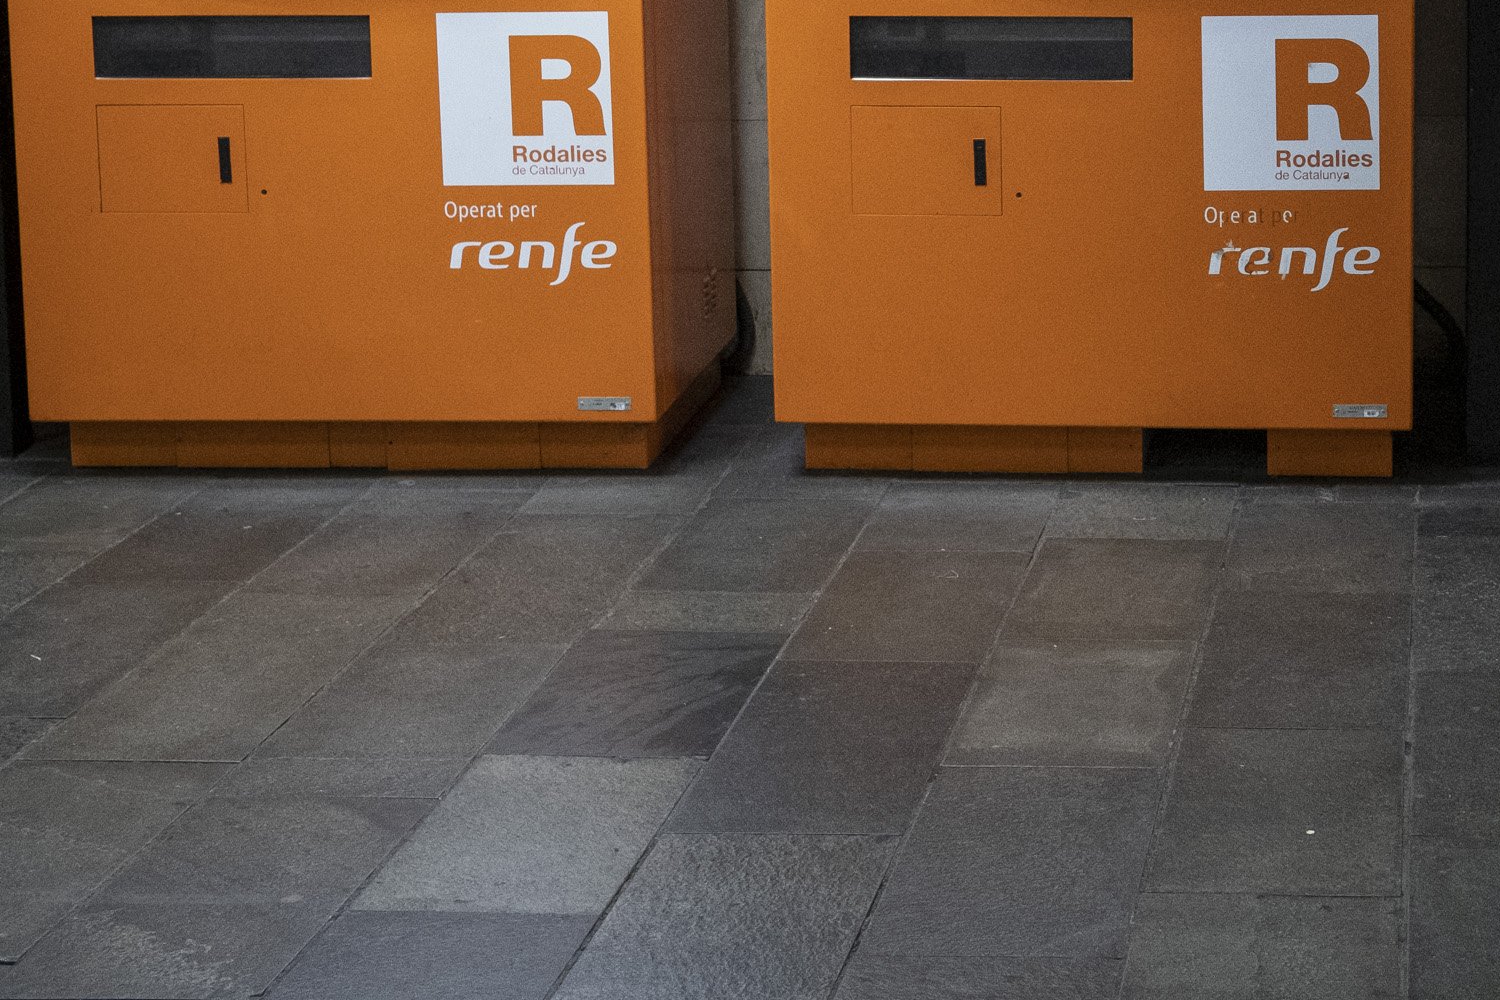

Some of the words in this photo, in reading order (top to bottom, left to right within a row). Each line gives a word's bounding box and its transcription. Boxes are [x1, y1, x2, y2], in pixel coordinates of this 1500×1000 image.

[512, 145, 607, 162] Rodalies
[1276, 150, 1374, 168] Rodalies
[512, 165, 526, 175] de
[529, 165, 585, 177] Catalunya
[1275, 170, 1289, 180] de
[1293, 170, 1350, 182] Catalunya
[444, 201, 503, 222] Operat
[510, 204, 537, 222] per
[450, 222, 617, 286] renfe
[1208, 227, 1381, 292] renfe
